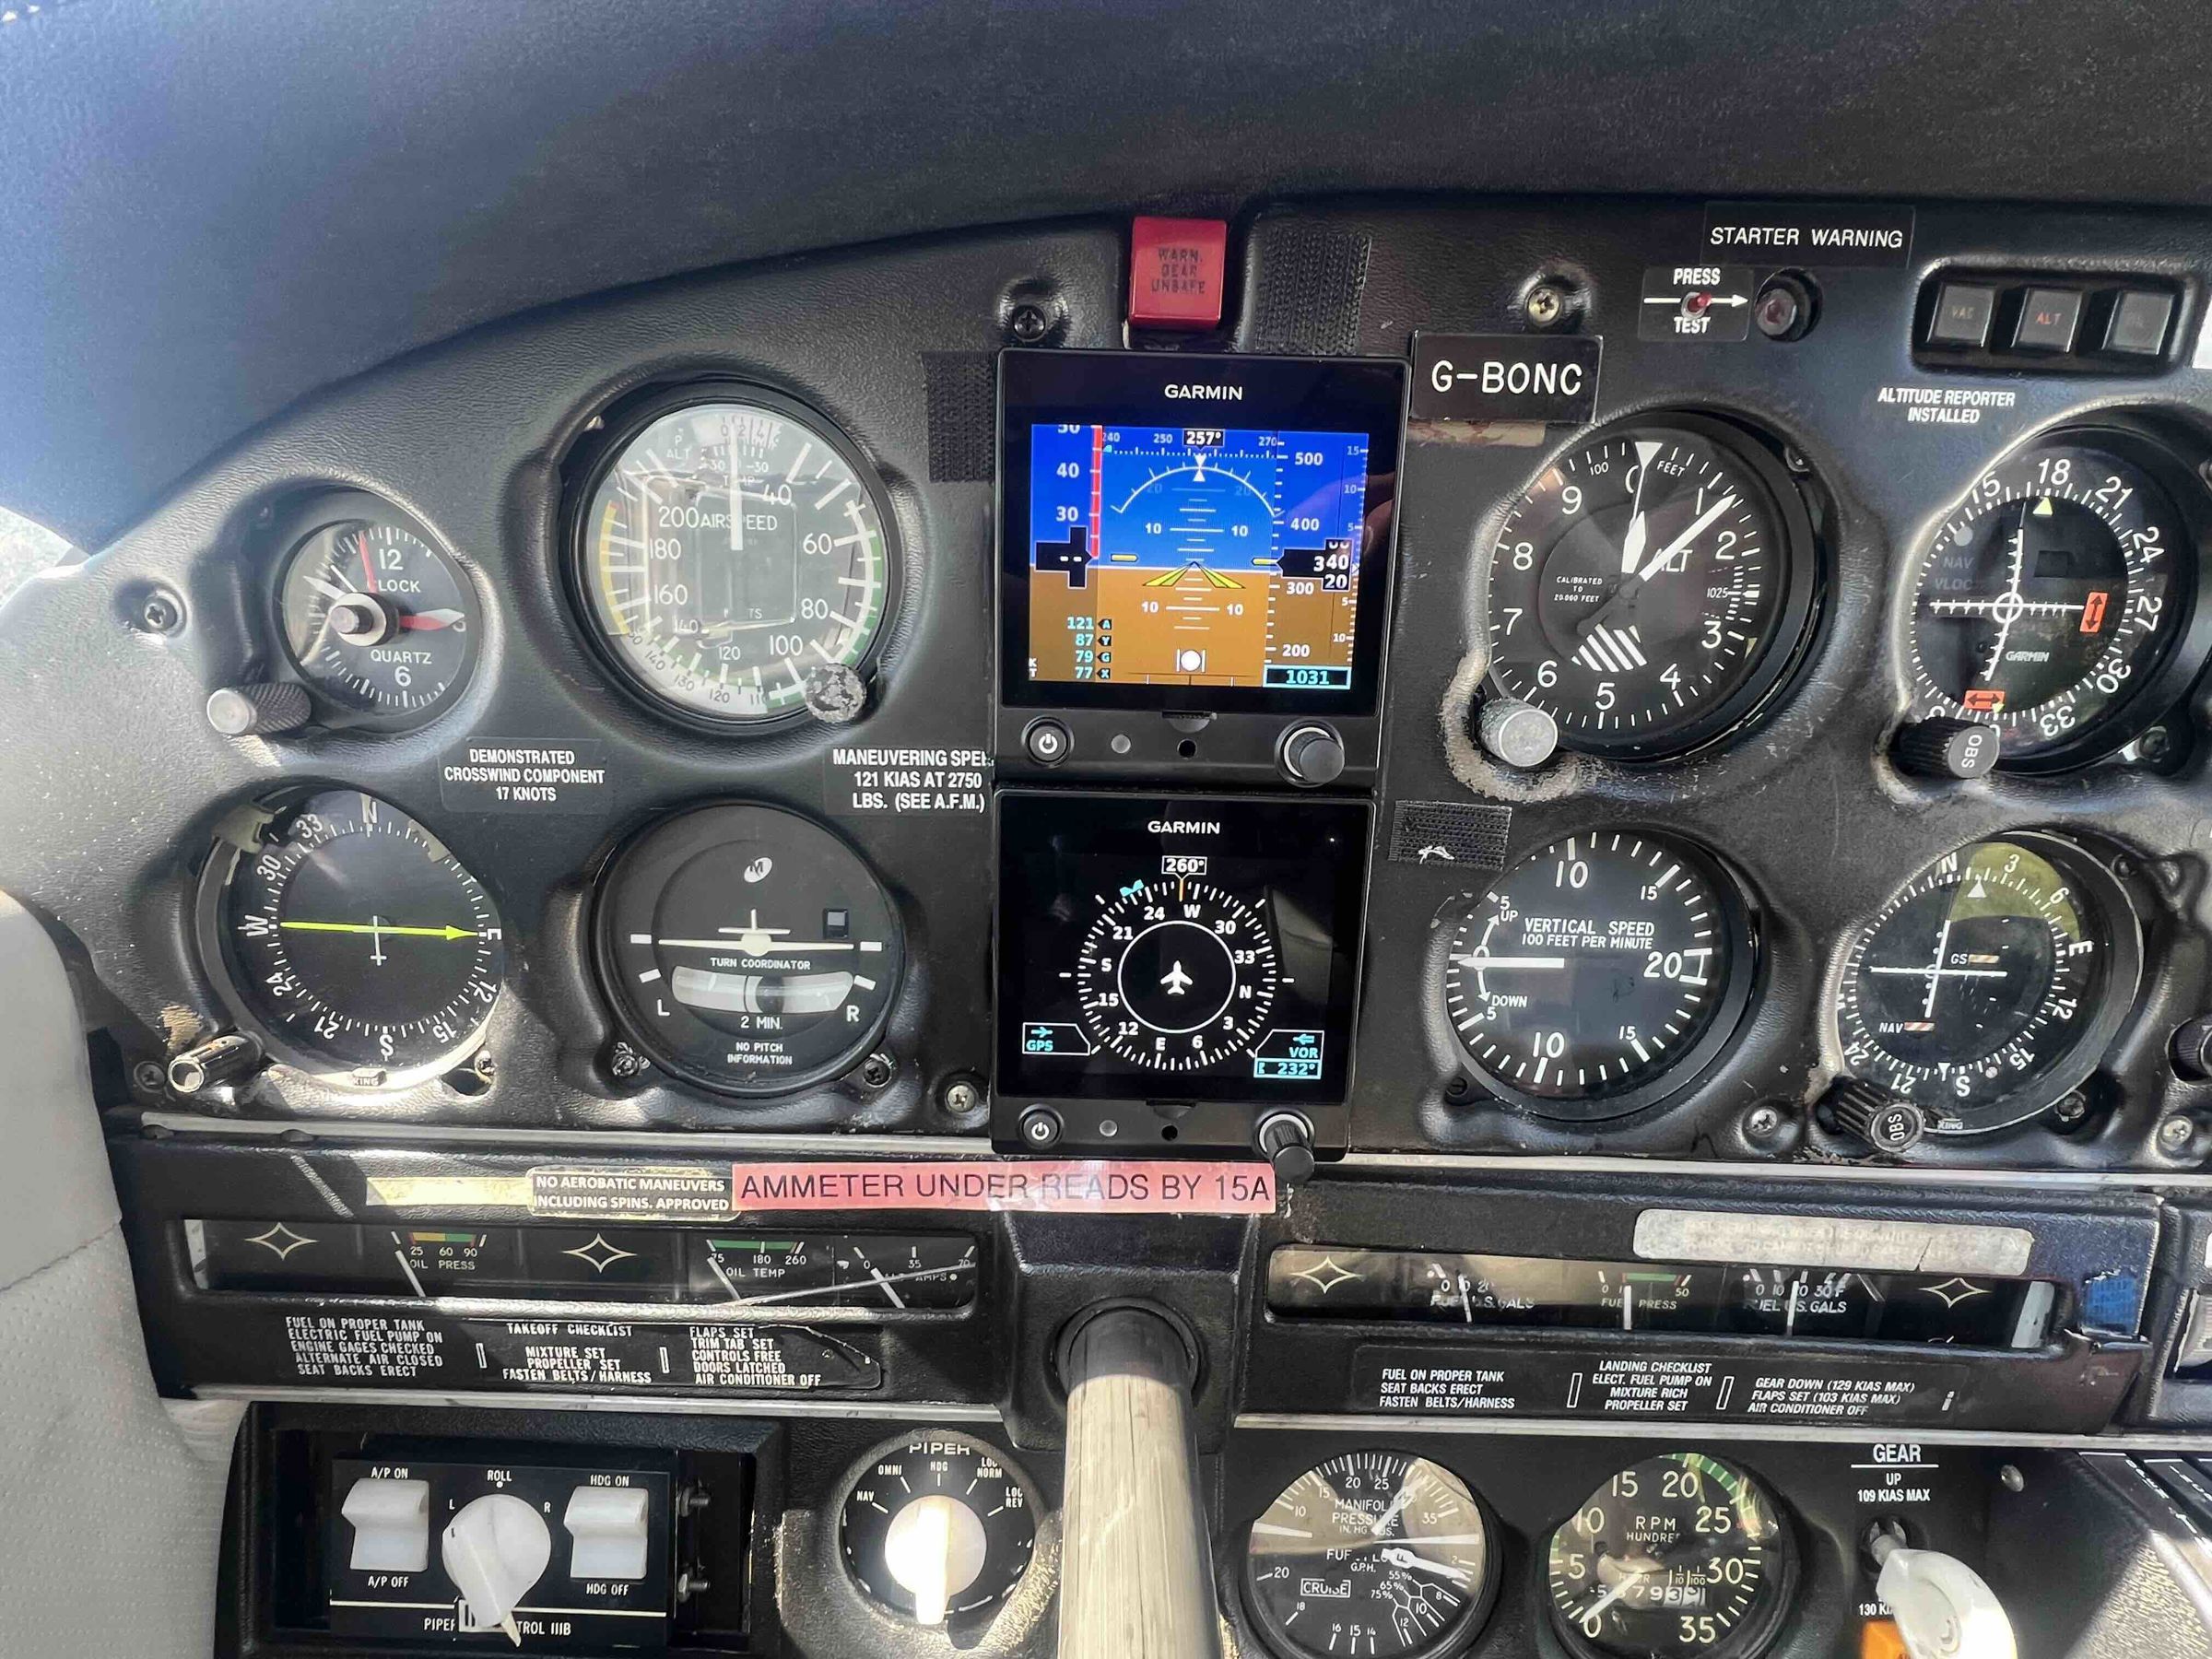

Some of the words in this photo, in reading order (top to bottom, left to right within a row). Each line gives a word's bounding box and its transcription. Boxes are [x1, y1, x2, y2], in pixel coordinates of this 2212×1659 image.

[1710, 227, 1800, 246] STARTER
[1810, 229, 1904, 249] WARNING
[1161, 265, 1197, 277] GEAR
[1673, 268, 1722, 286] PRESS
[1151, 279, 1206, 294] UNSAFE
[1673, 317, 1711, 334] TEST
[2036, 312, 2062, 325] ALT
[1430, 359, 1584, 396] G-BONC
[1164, 384, 1243, 400] GARMIN
[1877, 387, 1942, 404] ALTITUDE
[1944, 390, 2016, 406] REPORTER
[1907, 407, 1981, 424] INSTALLED
[1294, 453, 1324, 465] 500
[1656, 460, 1686, 477] FEET
[2037, 458, 2071, 485] 18
[658, 506, 700, 528] 200
[1290, 518, 1320, 531] 400
[649, 538, 681, 560] 180
[803, 533, 833, 555] 60
[1512, 542, 1533, 571] 8
[1286, 582, 1314, 594] 300
[801, 598, 829, 619] 80
[769, 635, 804, 656] 100
[1282, 644, 1311, 657] 200
[371, 649, 432, 665] QUARTZ
[1285, 670, 1330, 685] 1031
[469, 748, 575, 765] DEMONSTRATED
[833, 748, 947, 767] MANEUVERING
[444, 766, 521, 782] CROSSWIND
[524, 769, 606, 784] COMPONENT
[854, 771, 878, 787] 121
[883, 771, 921, 788] KIAS
[924, 771, 945, 788] AT
[947, 772, 982, 789] 2750
[496, 786, 510, 800] 17
[512, 786, 557, 802] KNOTS
[853, 793, 888, 809] LBS.
[895, 793, 931, 812] (SEE
[935, 794, 985, 814] A.F.M.)
[1147, 820, 1220, 834] GARMIN
[1524, 918, 1596, 935] VERTICAL
[1607, 921, 1655, 936] SPEED
[1521, 934, 1545, 946] 100
[1547, 935, 1579, 947] FEET
[1581, 935, 1606, 948] PER
[1609, 936, 1653, 949] MINUTE
[710, 957, 737, 967] TURN
[741, 959, 811, 971] COORDINATOR
[1643, 952, 1683, 979] 20
[1491, 995, 1528, 1008] DOWN
[1878, 1021, 1904, 1033] NAV
[735, 1041, 750, 1053] NO
[754, 1042, 783, 1053] PITCH
[1026, 1040, 1053, 1053] GPS
[1288, 1046, 1319, 1059] VOR
[727, 1053, 793, 1065] INFORMATION
[1888, 1112, 1907, 1141] OBS
[535, 1176, 558, 1188] NO
[560, 1177, 637, 1190] AEROBATIC
[639, 1179, 725, 1192] MANEUVERS
[740, 1173, 905, 1198] AMMETER
[915, 1174, 1029, 1199] UNDER
[1041, 1175, 1151, 1200] READS
[1161, 1178, 1203, 1201] BY
[1215, 1178, 1271, 1202] 15A
[535, 1195, 607, 1208] INCLUDING
[655, 1198, 729, 1211] APPROVED
[409, 1259, 429, 1269] OIL
[439, 1260, 476, 1271] PRESS
[725, 1267, 746, 1277] OIL
[753, 1268, 785, 1278] TEMP
[286, 1316, 314, 1328] FUEL
[319, 1317, 335, 1329] ON
[340, 1318, 387, 1331] PROPER
[394, 1319, 425, 1331] TANK
[507, 1323, 559, 1335] TAKEOFF
[567, 1324, 632, 1337] CHECKLIST
[290, 1340, 334, 1353] ENGINE
[338, 1341, 377, 1353] GAGES
[381, 1342, 434, 1355] CHECKED
[295, 1352, 361, 1365] ALTERNATE
[368, 1353, 389, 1365] AIR
[396, 1354, 443, 1367] CLOSED
[691, 1350, 750, 1362] CONTROLS
[754, 1350, 782, 1362] FREE
[299, 1364, 325, 1375] SEAT
[334, 1364, 372, 1376] BACKS
[380, 1365, 417, 1377] ERECT
[693, 1361, 730, 1373] DOORS
[735, 1362, 785, 1374] LATCHED
[1599, 1359, 1648, 1372] LANDING
[1650, 1361, 1712, 1374] CHECKLIST
[502, 1369, 547, 1381] FASTEN
[695, 1373, 714, 1385] AIR
[719, 1374, 795, 1386] CONDITIONER
[799, 1374, 821, 1386] OFF
[1382, 1369, 1407, 1381] FUEL
[1410, 1369, 1427, 1382] ON
[1430, 1370, 1473, 1382] PROPER
[1476, 1371, 1505, 1382] TANK
[1592, 1373, 1626, 1385] ELECT.
[1630, 1374, 1657, 1386] FUEL
[1659, 1374, 1691, 1387] PUMP
[1694, 1375, 1713, 1386] ON
[1380, 1382, 1407, 1394] SEAT
[1409, 1382, 1447, 1395] BACKS
[1449, 1382, 1483, 1395] ERECT
[1609, 1386, 1658, 1398] MIXTURE
[1660, 1386, 1688, 1398] RICH
[1755, 1377, 1784, 1389] GEAR
[1787, 1378, 1825, 1390] DOWN
[1827, 1378, 1852, 1392] (129
[1853, 1380, 1882, 1392] KIAS
[1884, 1381, 1916, 1394] MAX)
[1379, 1395, 1418, 1408] FASTEN
[1425, 1396, 1515, 1409] BELTS/HARNESS
[1604, 1399, 1664, 1411] PROPELLER
[1666, 1400, 1688, 1412] SET
[1751, 1390, 1785, 1402] FLAPS
[1787, 1391, 1810, 1403] SET
[1813, 1391, 1838, 1405] (103
[1840, 1392, 1868, 1405] KIAS
[1870, 1393, 1901, 1406] MAX)
[1747, 1402, 1767, 1414] AIR
[1769, 1403, 1845, 1416] CONDITIONER
[1846, 1404, 1869, 1417] OFF
[909, 1442, 971, 1456] PIPER
[1872, 1444, 1922, 1464] GEAR
[371, 1466, 391, 1480] A/P
[394, 1467, 409, 1479] ON
[487, 1470, 512, 1483] ROLL
[877, 1465, 902, 1476] OMNI
[977, 1467, 1003, 1478] NORM
[1662, 1471, 1699, 1499] 20
[1885, 1473, 1902, 1486] UP
[856, 1490, 875, 1501] NAV
[1856, 1489, 1876, 1502] 109
[1878, 1488, 1905, 1502] KIAS
[1906, 1488, 1931, 1502] MAX
[1695, 1505, 1732, 1534] 25
[1706, 1557, 1744, 1584] 30
[368, 1575, 388, 1589] A/P
[390, 1576, 409, 1588] OFF
[585, 1583, 607, 1595] HDG
[610, 1583, 629, 1595] OFF
[1678, 1616, 1716, 1643] 35
